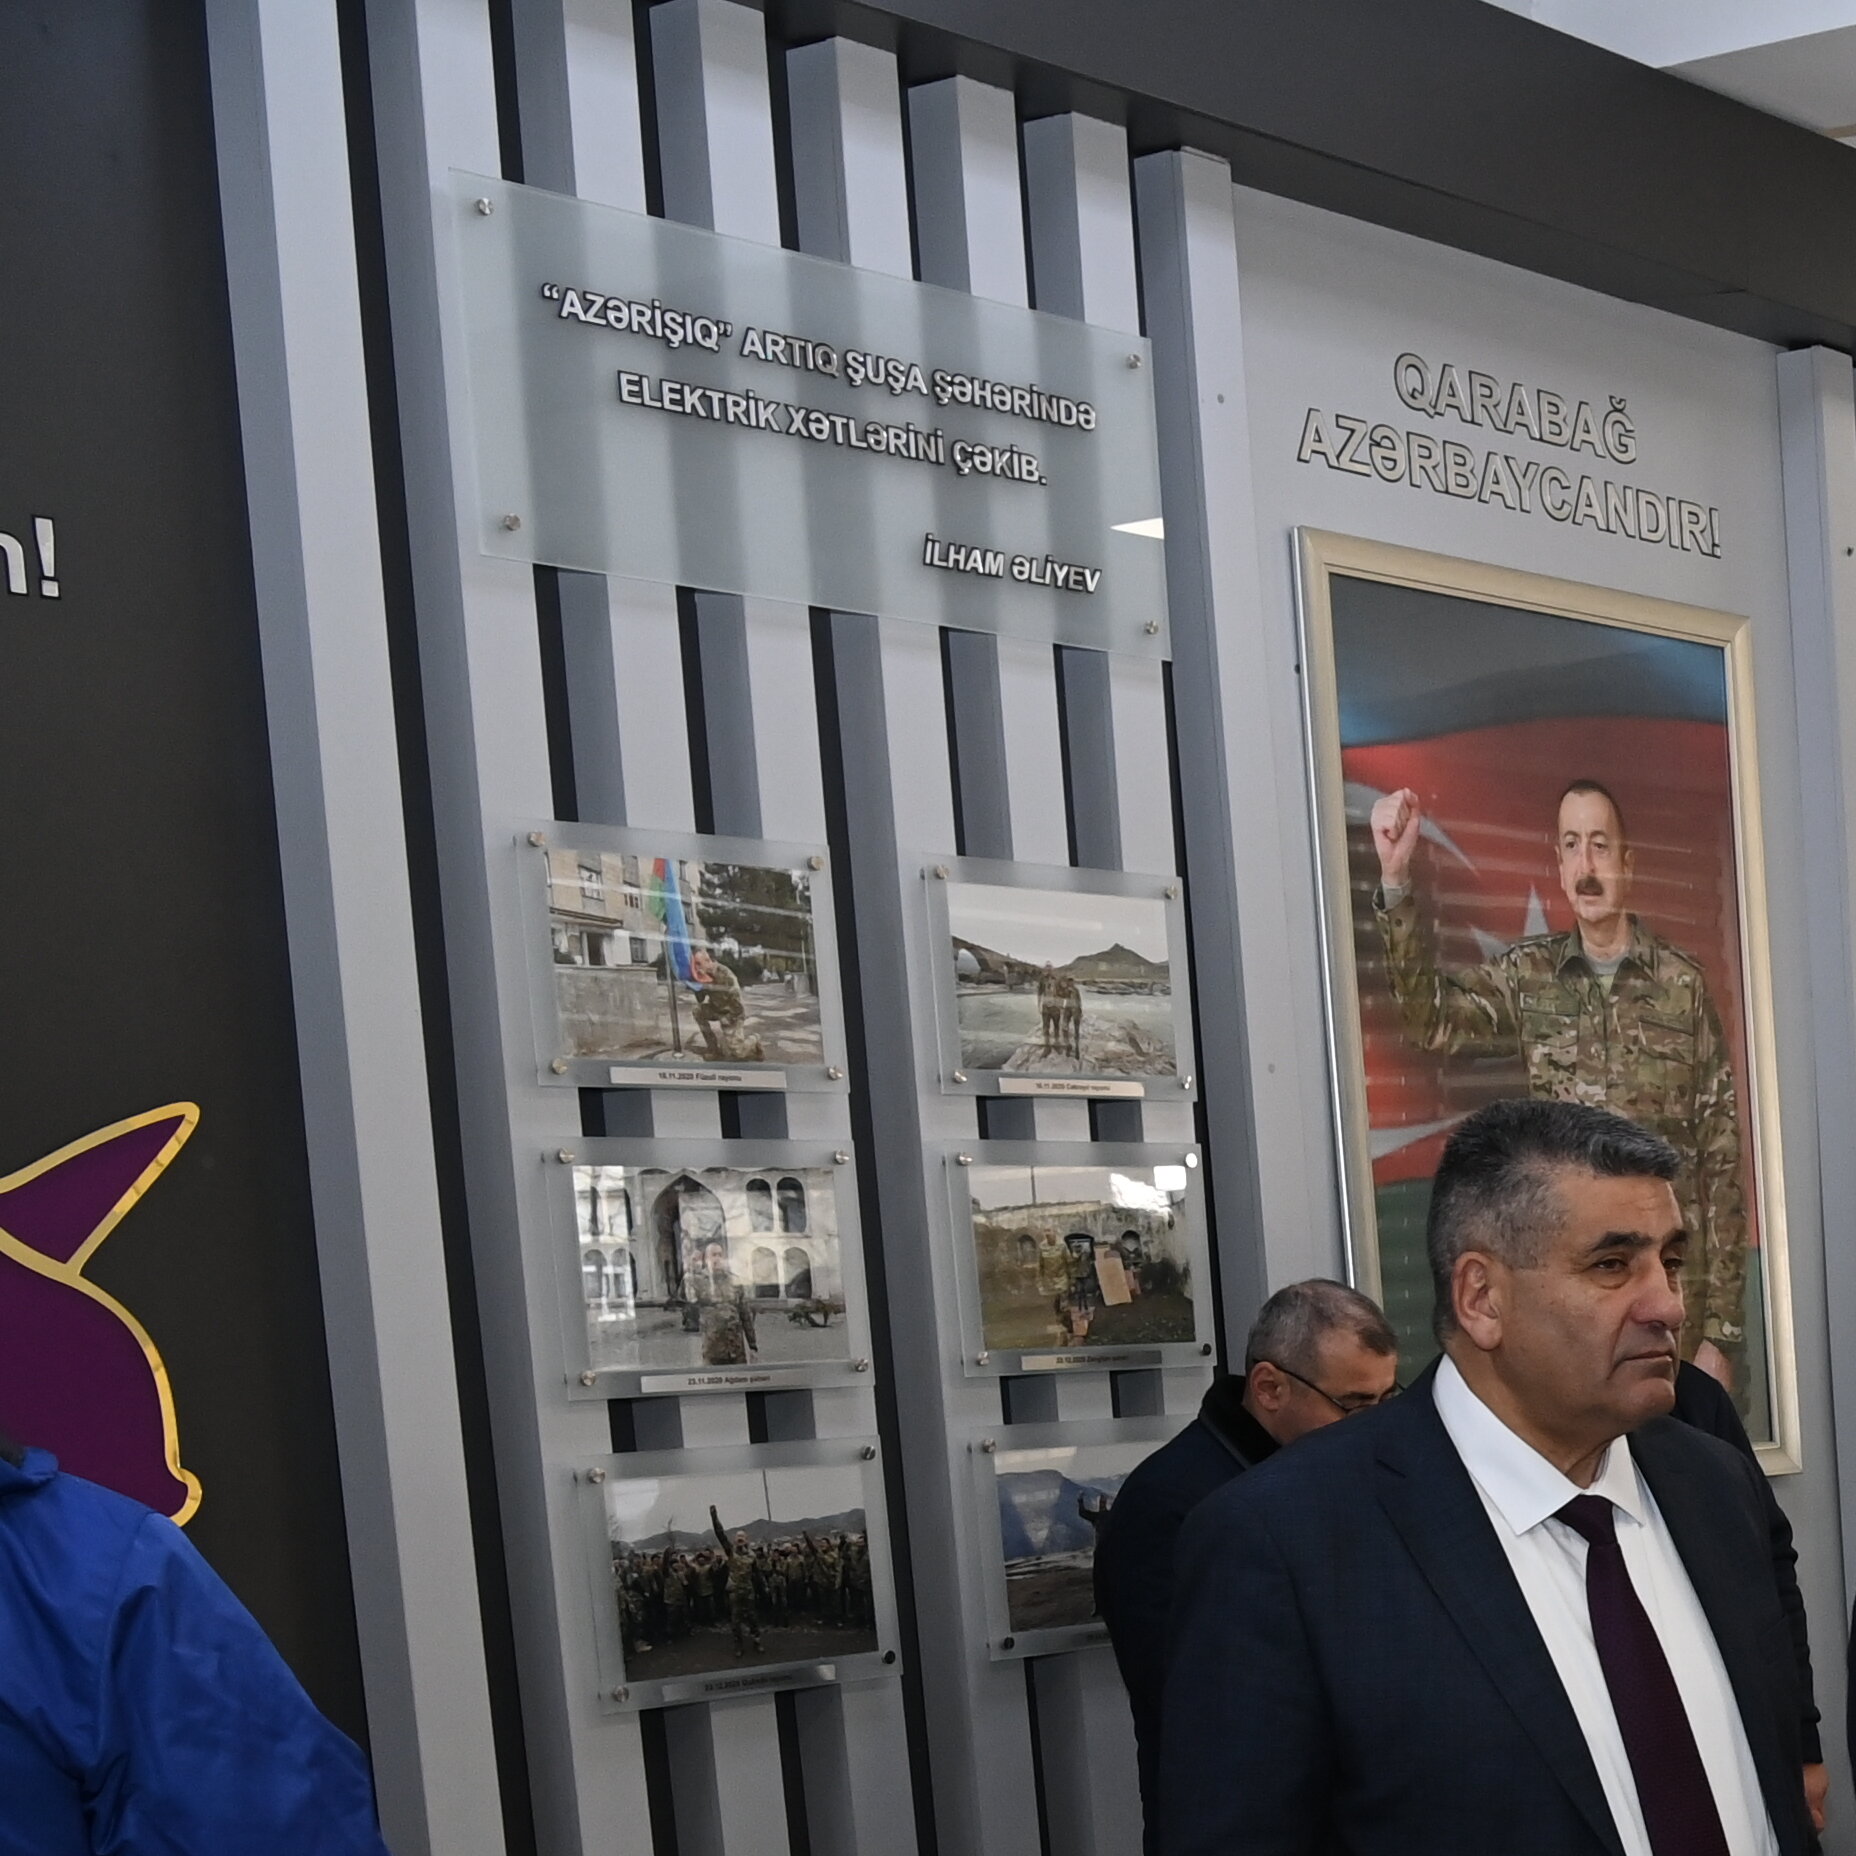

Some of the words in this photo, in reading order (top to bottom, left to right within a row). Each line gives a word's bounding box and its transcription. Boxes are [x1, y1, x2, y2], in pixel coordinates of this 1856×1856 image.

[616, 370, 781, 434] ELEKTRİK
[783, 407, 946, 466] XƏTLƏRİNİ
[951, 439, 1049, 486] ÇƏKİB.
[742, 328, 839, 379] ARTIQ
[845, 349, 929, 397] ŞUŞA
[932, 368, 1098, 431] ŞƏHƏRİNDƏ
[1394, 352, 1637, 465] QARABAĞ
[1297, 408, 1722, 558] AZƏRBAYCANDIR!
[922, 532, 1005, 578] İLHAM
[1009, 551, 1102, 595] ƏLİYEV
